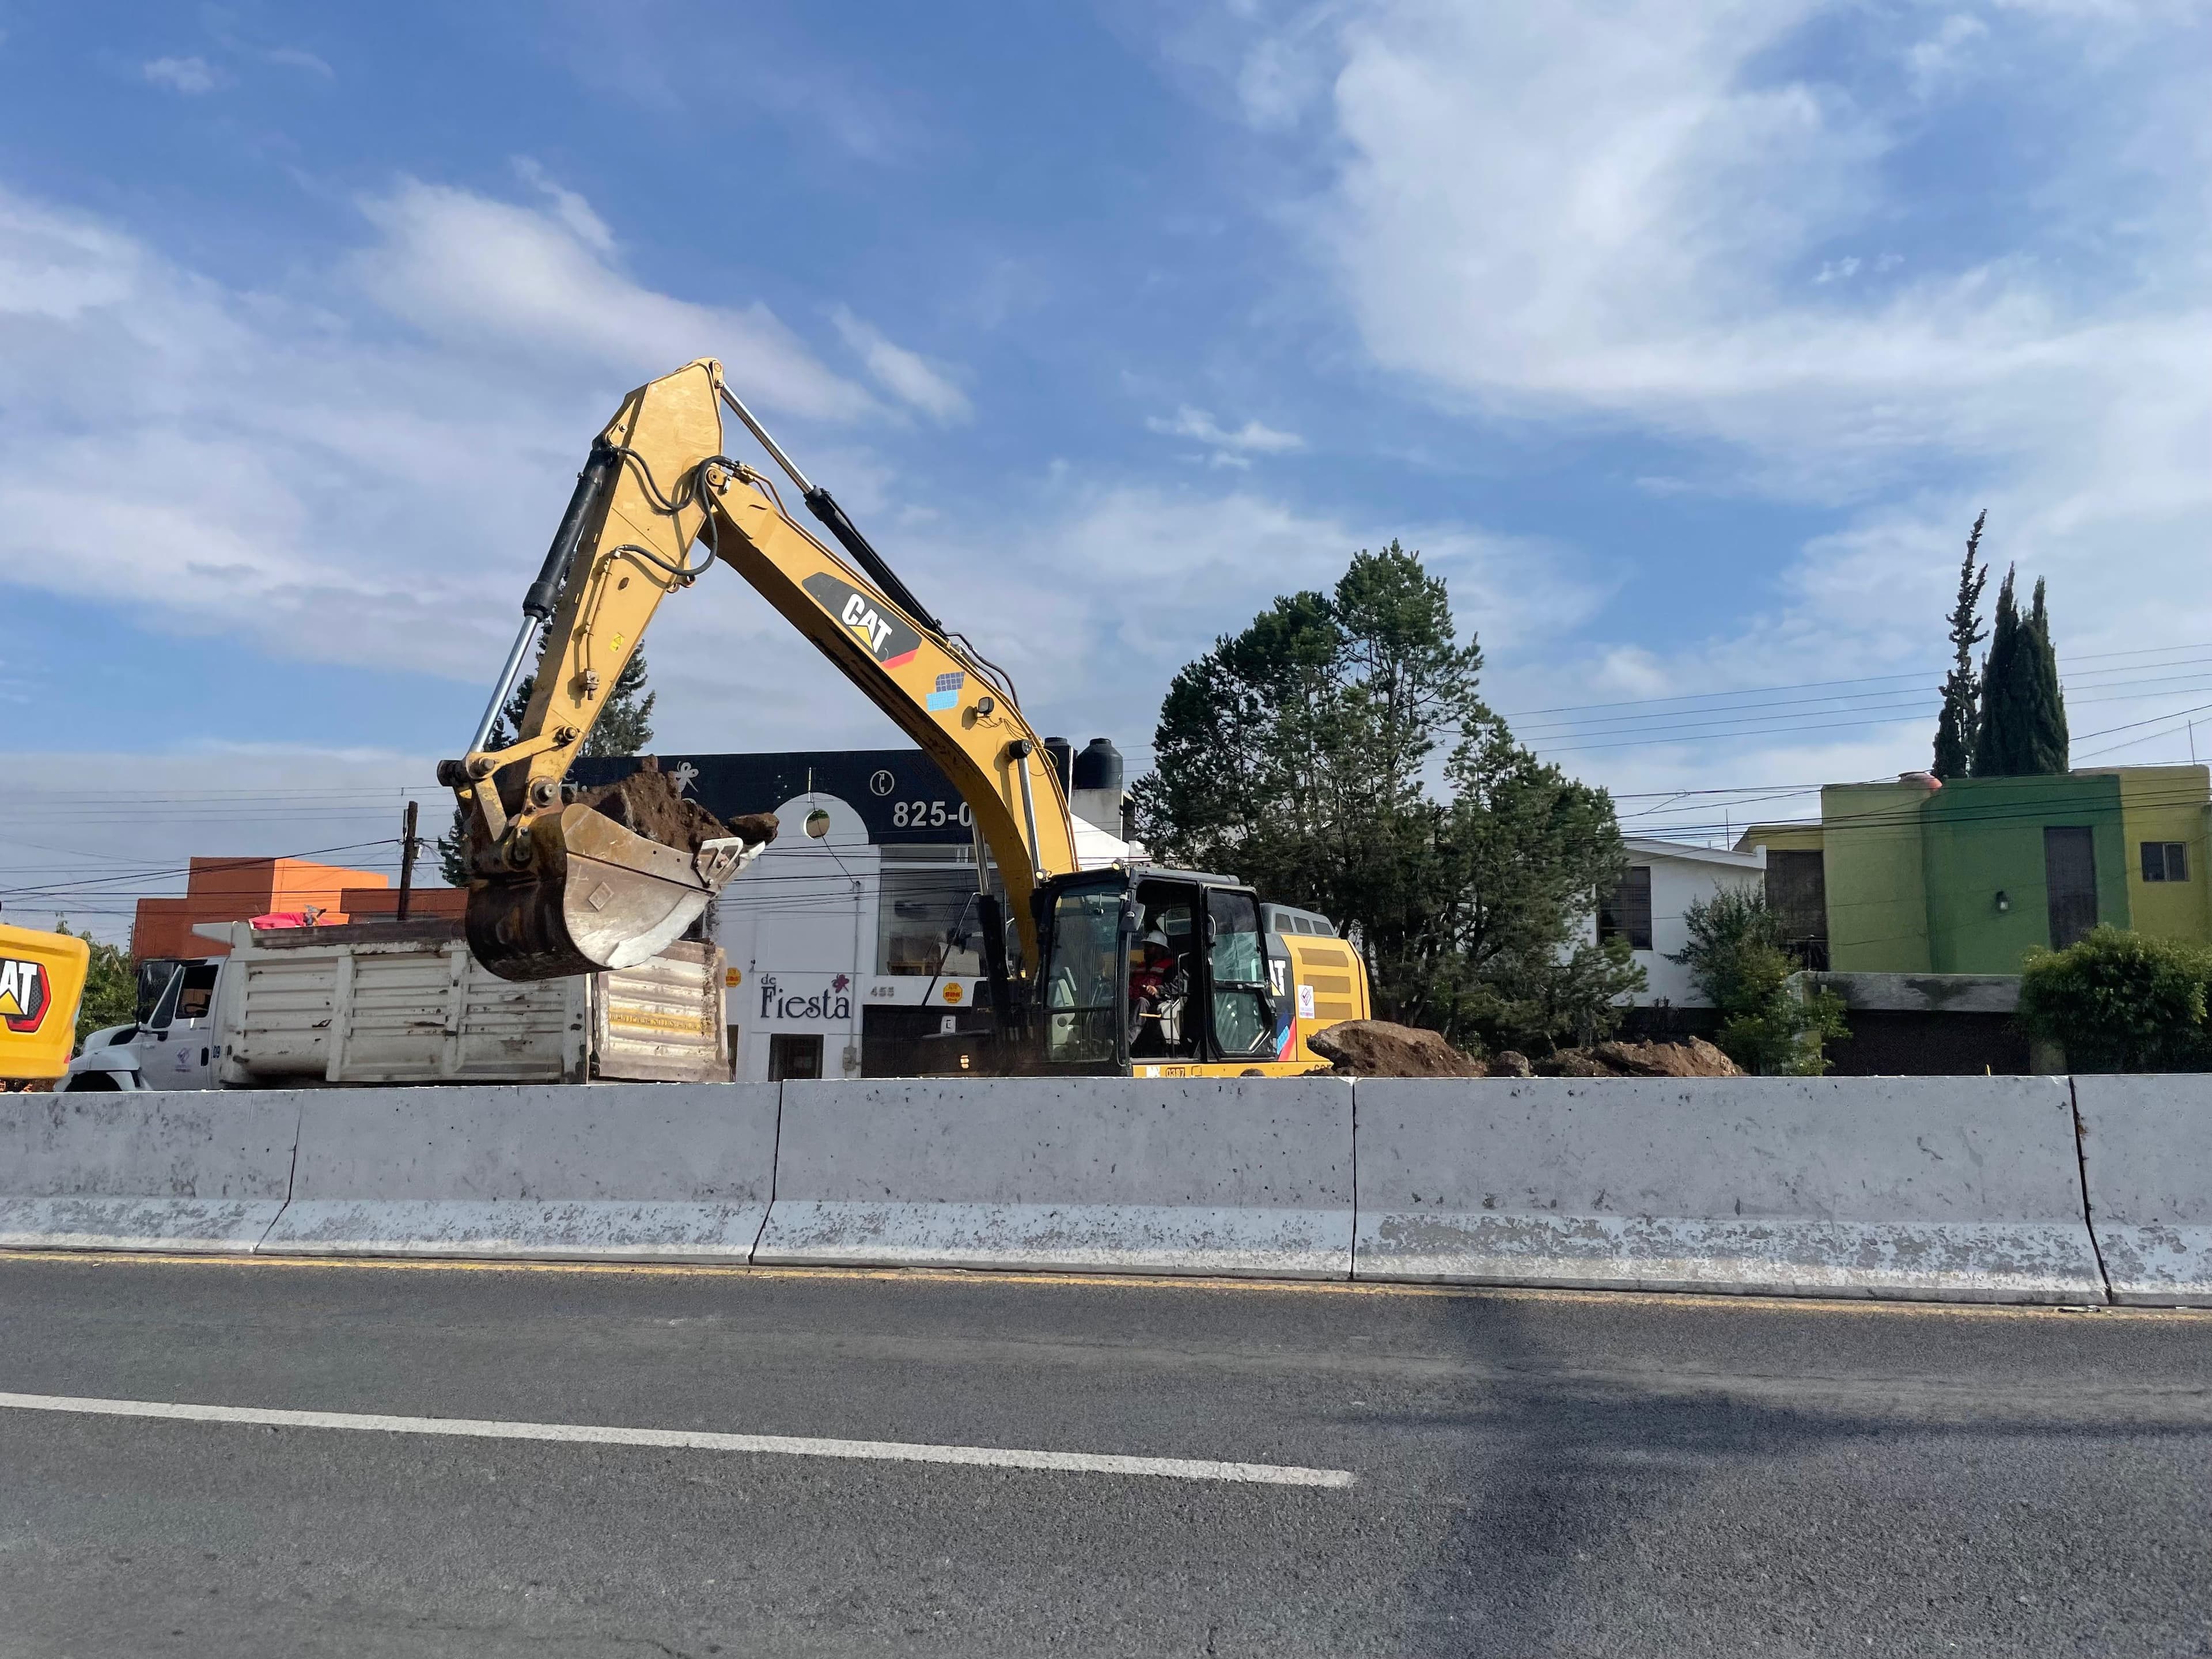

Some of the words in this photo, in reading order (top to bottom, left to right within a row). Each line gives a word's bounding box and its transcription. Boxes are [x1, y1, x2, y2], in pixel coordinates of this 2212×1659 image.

[841, 593, 893, 653] CAT
[893, 801, 972, 827] 825-0
[0, 960, 37, 1015] AT
[761, 973, 777, 984] de
[760, 985, 851, 1019] Fiesta
